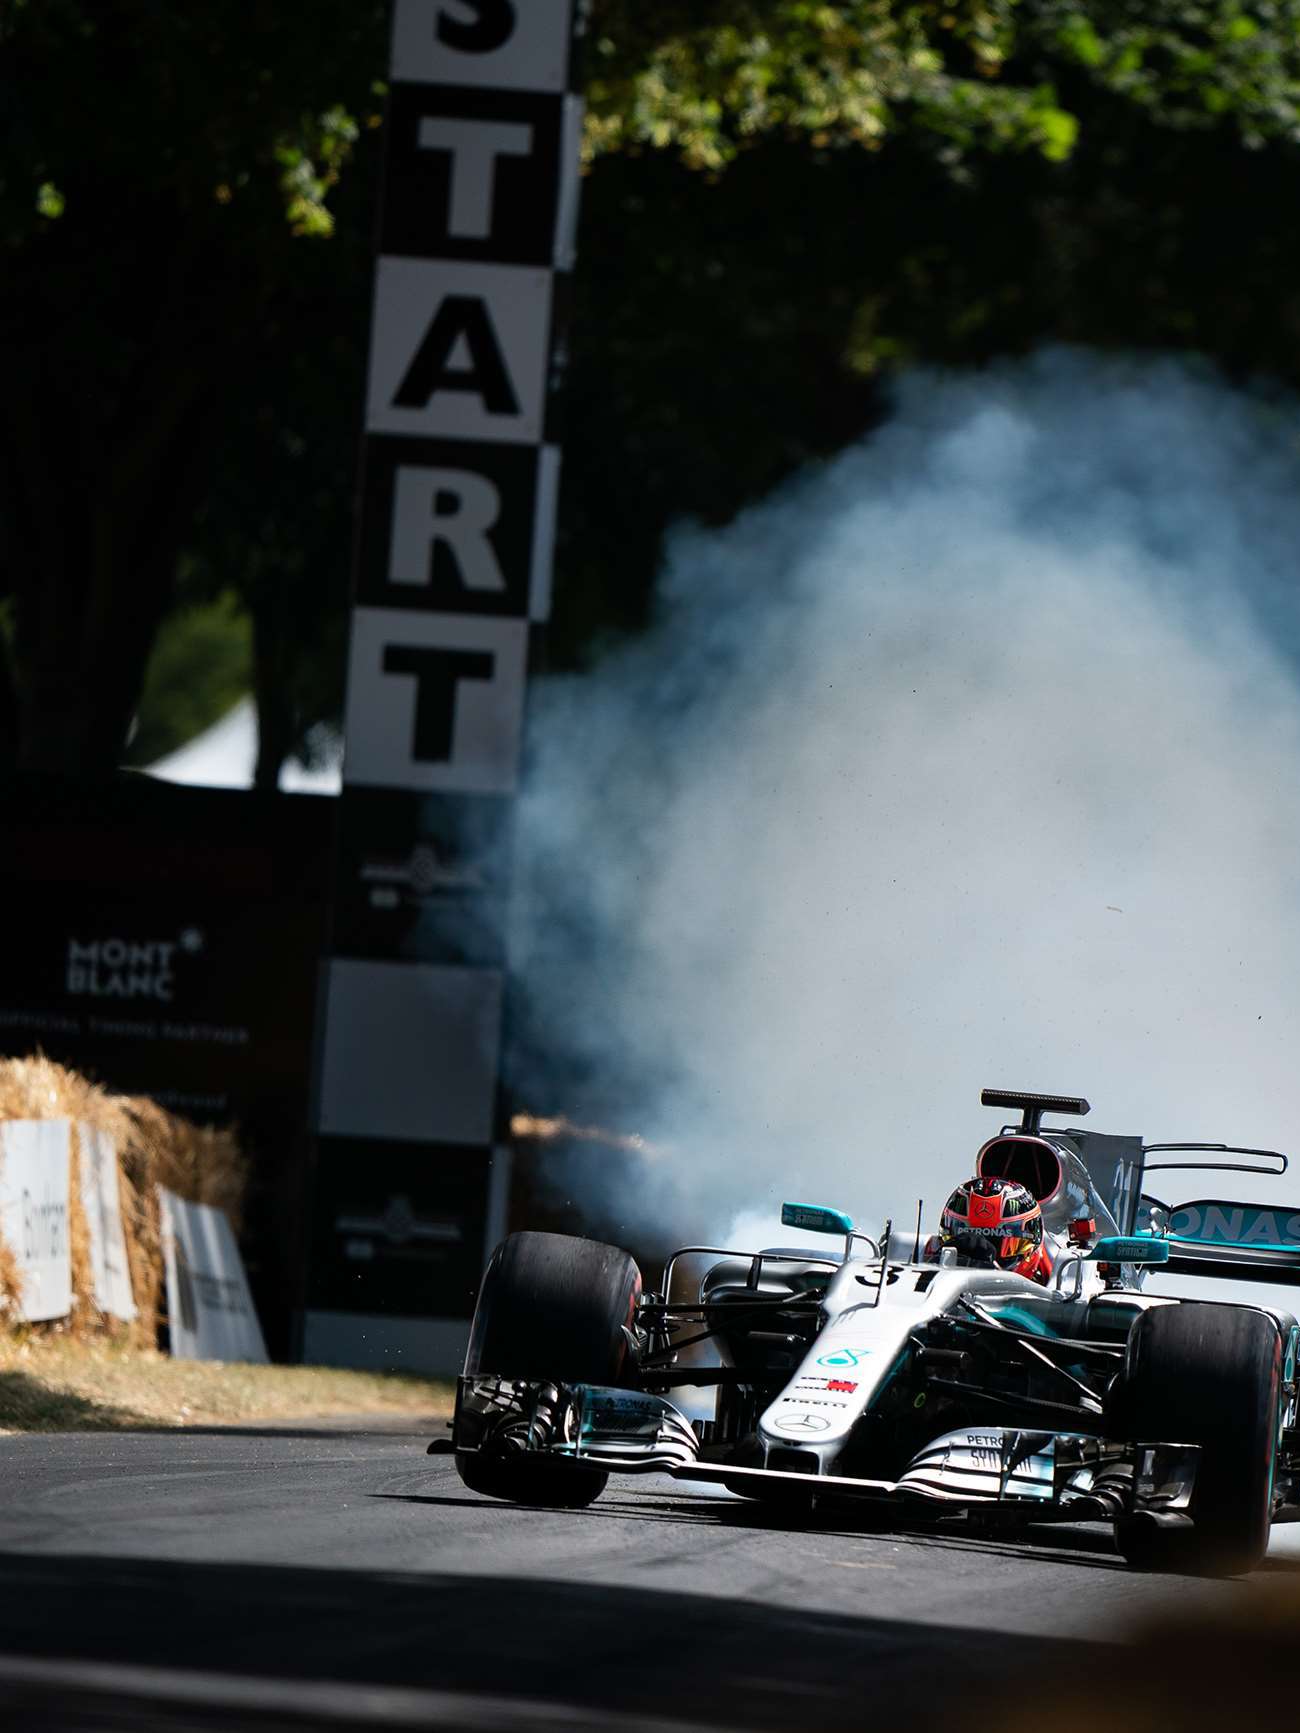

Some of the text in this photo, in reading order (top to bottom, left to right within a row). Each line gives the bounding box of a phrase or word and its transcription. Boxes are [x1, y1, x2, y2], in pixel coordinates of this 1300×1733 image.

[68, 937, 175, 968] MONT
[66, 965, 174, 1002] BLANC
[957, 1226, 1014, 1238] PETRONAS
[854, 1264, 940, 1293] 31
